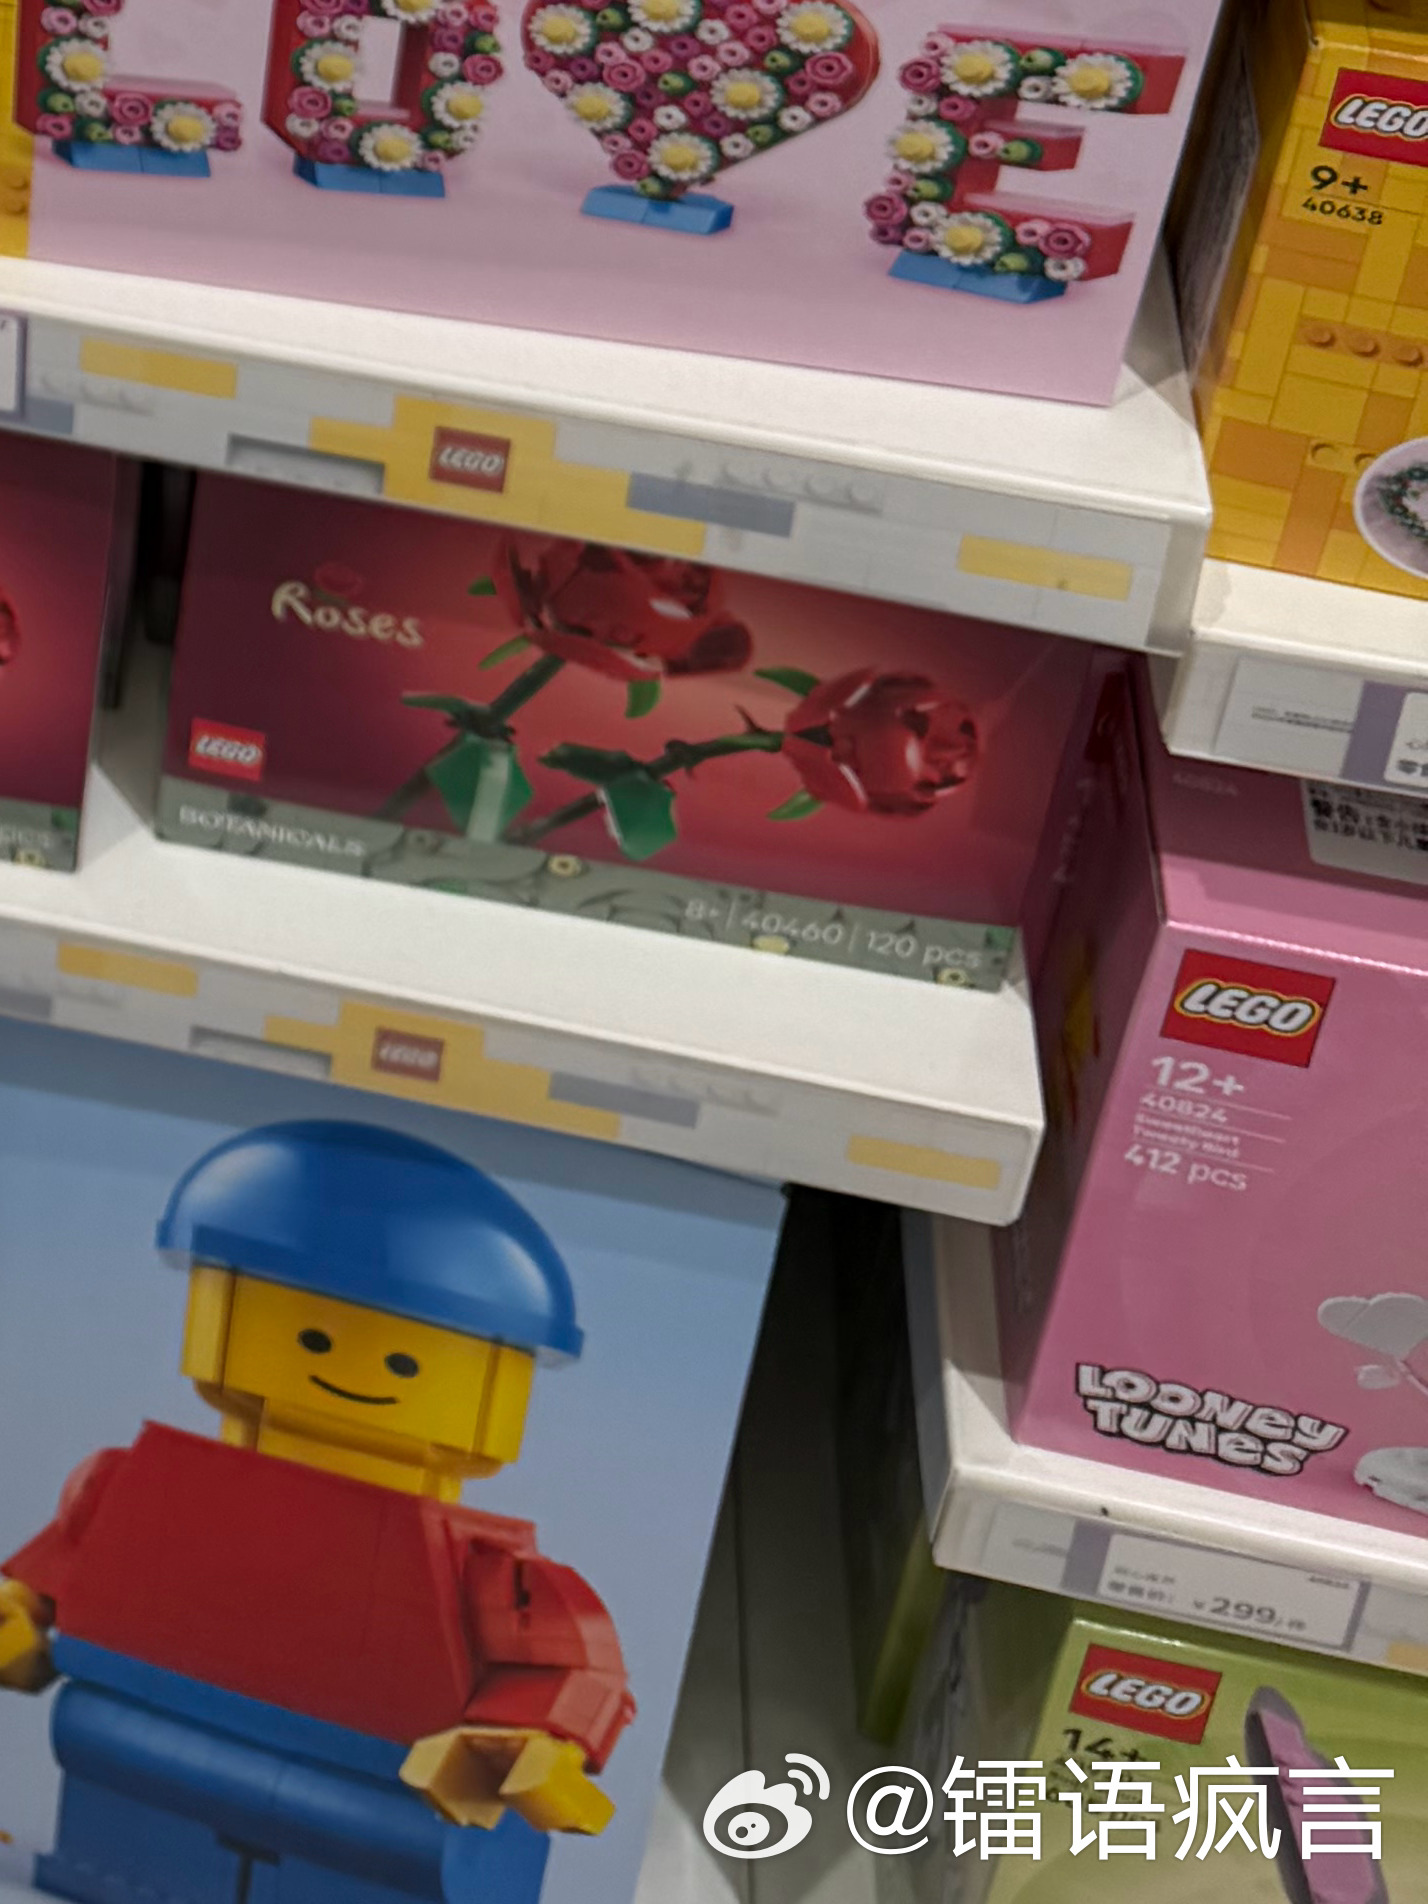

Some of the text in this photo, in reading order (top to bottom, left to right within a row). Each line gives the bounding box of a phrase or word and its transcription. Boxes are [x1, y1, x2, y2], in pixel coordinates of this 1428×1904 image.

[1335, 97, 1428, 140] LEGO
[1311, 165, 1367, 194] 9+
[1303, 197, 1383, 226] 40638
[438, 443, 504, 478] LEGO
[270, 579, 425, 650] Roses
[194, 733, 262, 767] LEGO
[178, 806, 365, 856] BOTANICALS
[685, 898, 983, 973] 8+ 40460 120 pcs
[1182, 982, 1314, 1034] LEGO
[378, 1038, 438, 1071] LEGO
[1152, 1055, 1244, 1097] 12+
[1140, 1092, 1228, 1124] 40824
[1124, 1144, 1248, 1191] 412 pcs
[1087, 1671, 1207, 1717] LEGO
